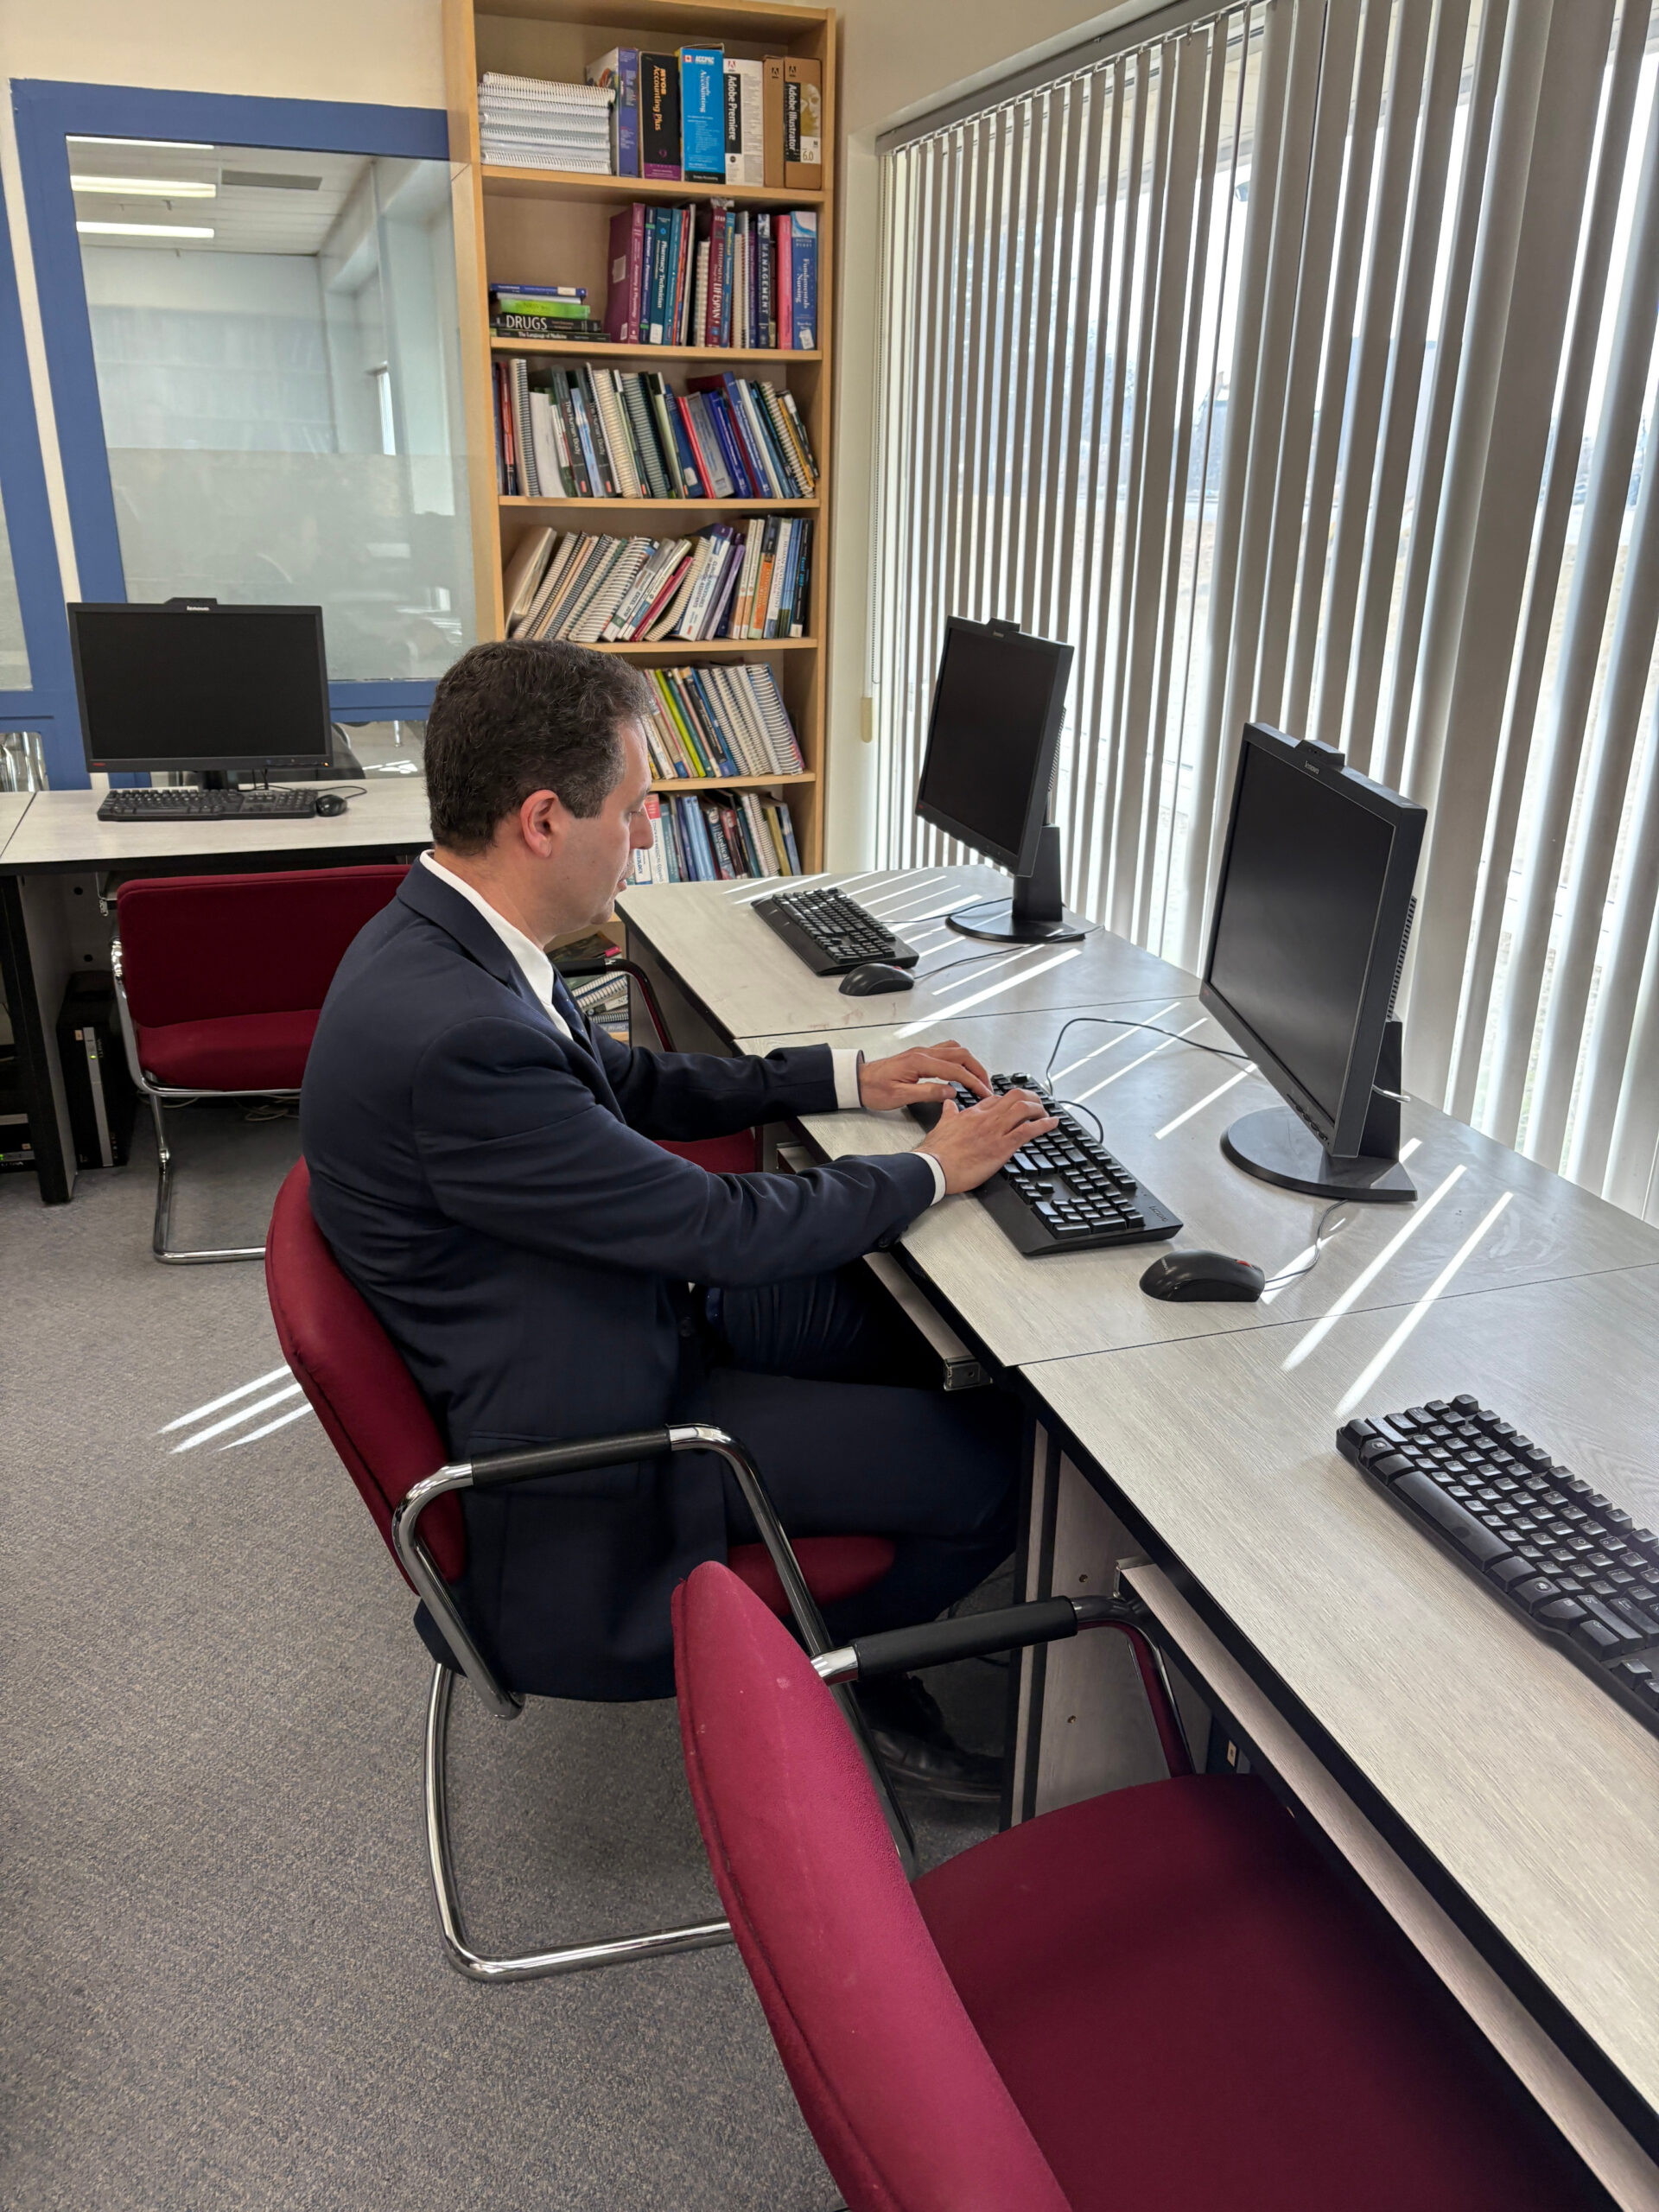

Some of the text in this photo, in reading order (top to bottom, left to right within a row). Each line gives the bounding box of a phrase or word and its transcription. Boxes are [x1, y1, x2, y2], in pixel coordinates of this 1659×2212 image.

[653, 66, 663, 130] Accounting Plus
[728, 75, 737, 99] Adobe
[788, 84, 798, 111] Adobe
[728, 100, 738, 140] Premiere
[789, 111, 798, 151] Illustrator
[803, 150, 814, 162] 6.0
[658, 241, 667, 272] Pharmacy
[712, 283, 721, 318] LIFESPAN
[505, 315, 548, 331] DRUGS
[568, 415, 577, 437] Human
[592, 414, 601, 437] Human
[597, 439, 606, 455] Body
[629, 591, 641, 607] EXCEL
[1304, 760, 1319, 774] lenovo
[717, 831, 729, 861] Medical
